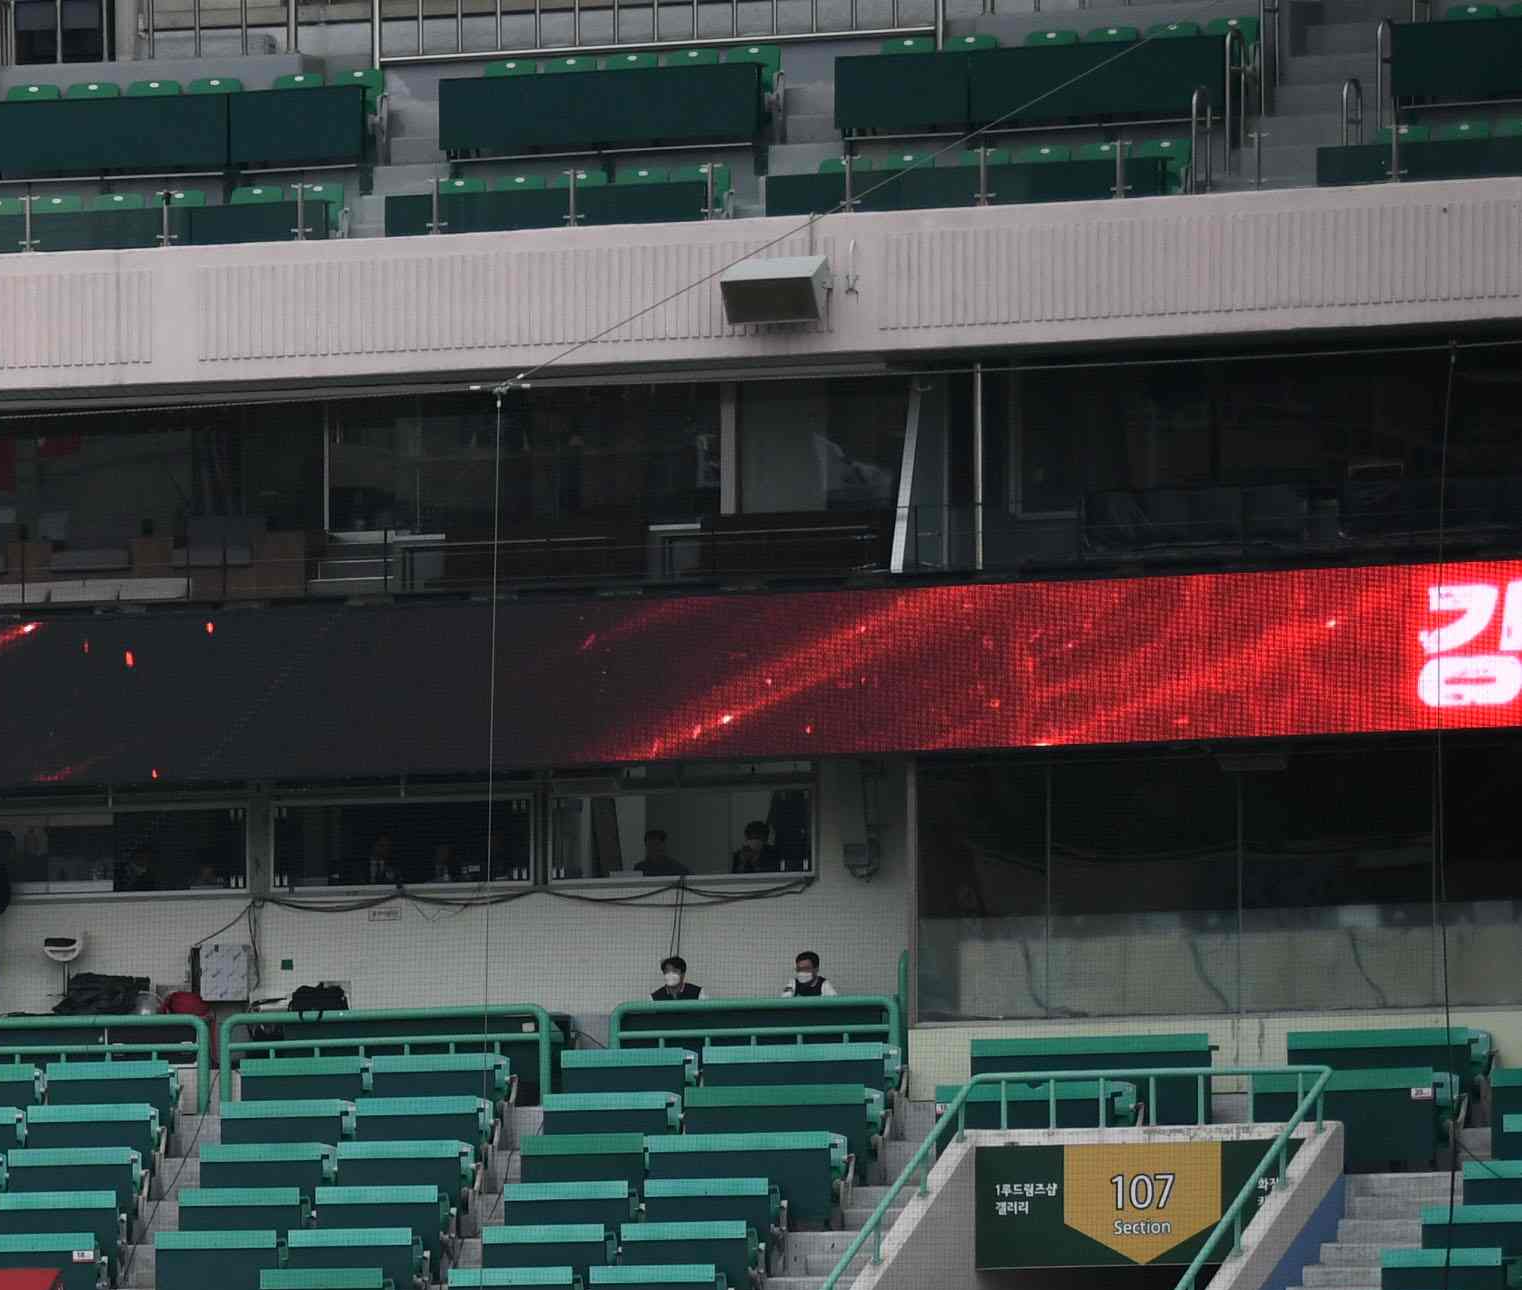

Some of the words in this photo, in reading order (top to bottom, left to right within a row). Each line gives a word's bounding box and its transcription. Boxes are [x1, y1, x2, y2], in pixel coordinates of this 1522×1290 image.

[1110, 1173, 1175, 1212] 107
[995, 1201, 1030, 1216] 갤러리
[1113, 1219, 1172, 1238] Section
